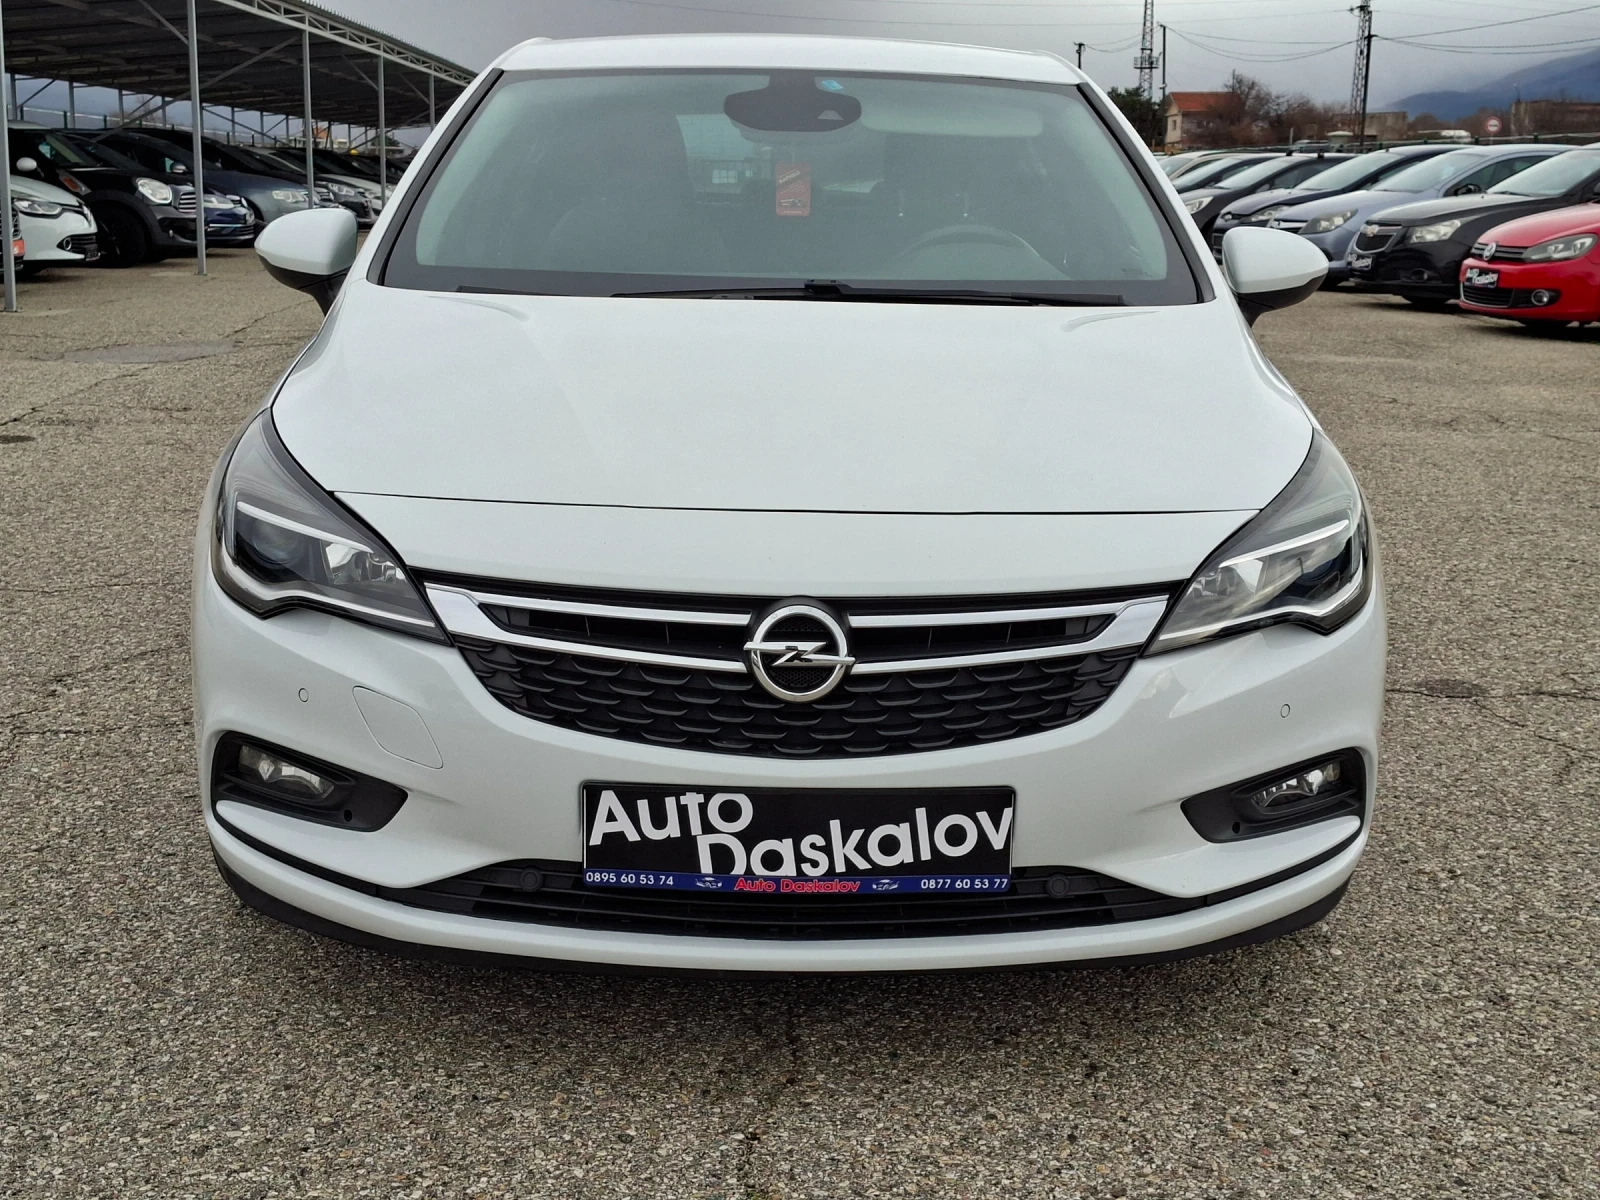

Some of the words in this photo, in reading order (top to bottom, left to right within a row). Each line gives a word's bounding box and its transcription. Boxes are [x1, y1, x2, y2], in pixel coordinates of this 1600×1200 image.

[589, 790, 754, 846] Auto
[696, 807, 1013, 877] Daskalov
[586, 872, 617, 883] 0895
[620, 873, 636, 884] 60
[639, 874, 655, 885] 53
[659, 875, 674, 886] 74
[734, 877, 776, 892] Auto
[780, 879, 860, 893] Daskalov
[920, 879, 951, 889] 0877
[955, 878, 971, 889] 60
[974, 878, 989, 889] 53
[993, 878, 1008, 889] 77
